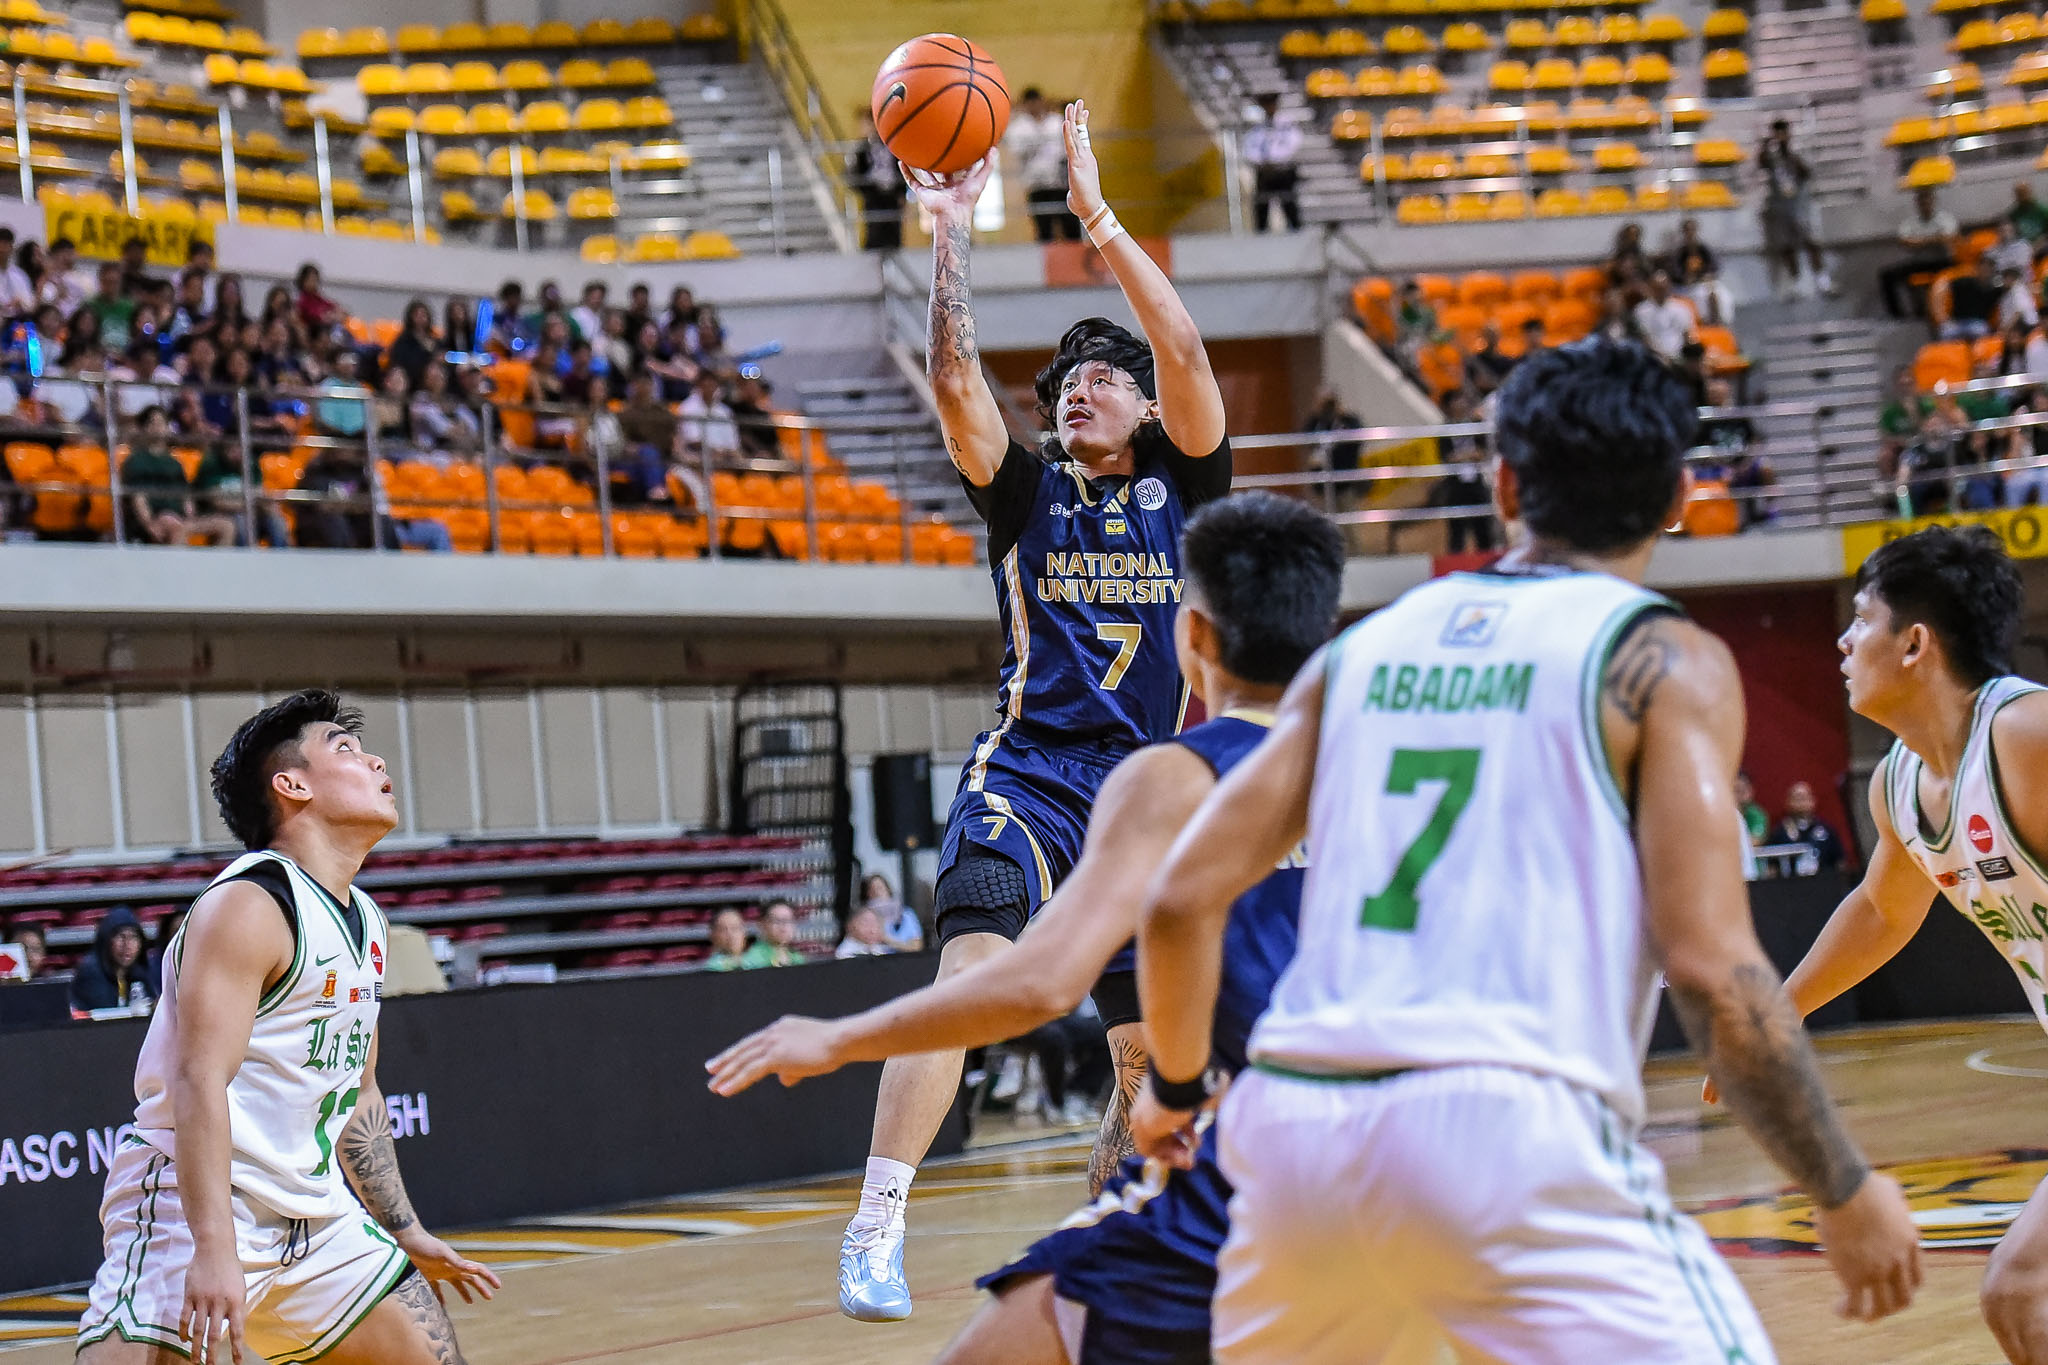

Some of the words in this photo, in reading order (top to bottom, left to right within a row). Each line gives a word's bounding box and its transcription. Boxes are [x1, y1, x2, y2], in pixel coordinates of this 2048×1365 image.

[1046, 552, 1174, 577] NATIONAL
[1037, 578, 1185, 604] UNIVERSITY
[1095, 622, 1142, 691] 7
[1361, 663, 1535, 714] ABADAM
[982, 816, 1008, 840] 7
[1358, 748, 1484, 932] 7
[301, 1018, 341, 1071] La
[0, 1130, 80, 1185] ASC
